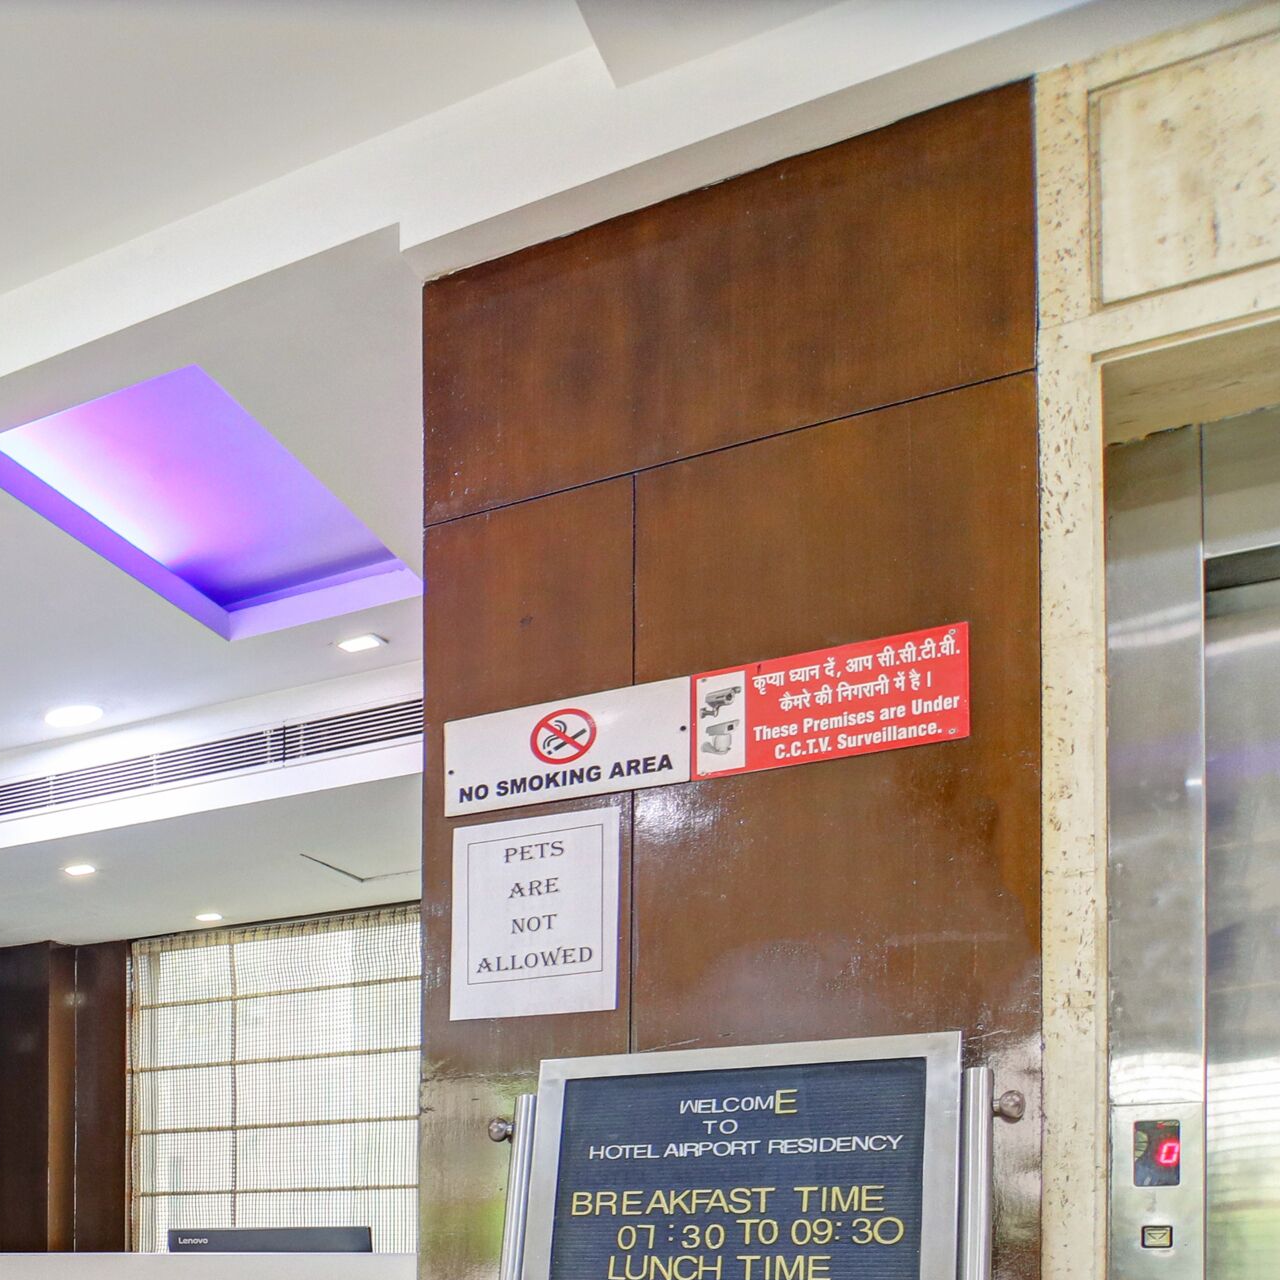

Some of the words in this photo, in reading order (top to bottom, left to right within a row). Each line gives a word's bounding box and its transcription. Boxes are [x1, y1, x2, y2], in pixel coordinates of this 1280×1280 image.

[752, 671, 785, 695] कृप्या
[789, 664, 820, 683] ध्यान
[845, 655, 873, 674] आप
[778, 690, 811, 712] कैमरे
[815, 684, 833, 706] की
[836, 674, 890, 702] निगरानी
[893, 671, 906, 692] में
[753, 722, 799, 743] These
[802, 708, 876, 734] Premises
[879, 704, 906, 720] are
[911, 694, 961, 716] Under
[774, 738, 833, 760] C.C.T.V.
[837, 721, 943, 750] Surveillance.
[458, 784, 489, 803] NO
[495, 765, 602, 797] SMOKING
[608, 753, 674, 780] AREA
[503, 840, 565, 864] PETS
[507, 877, 560, 899] ARE
[510, 913, 557, 935] NOT
[475, 946, 593, 974] ALLOWED
[679, 1089, 799, 1115] WELCOME
[702, 1119, 739, 1136] TO
[589, 1144, 660, 1160] HOTEL
[663, 1139, 762, 1158] AIRPORT
[768, 1134, 904, 1155] RESIDENCY
[571, 1187, 776, 1216] BREAKFAST
[793, 1184, 885, 1214] TIME
[178, 1236, 209, 1245] Lenovo
[736, 1218, 779, 1246] TO
